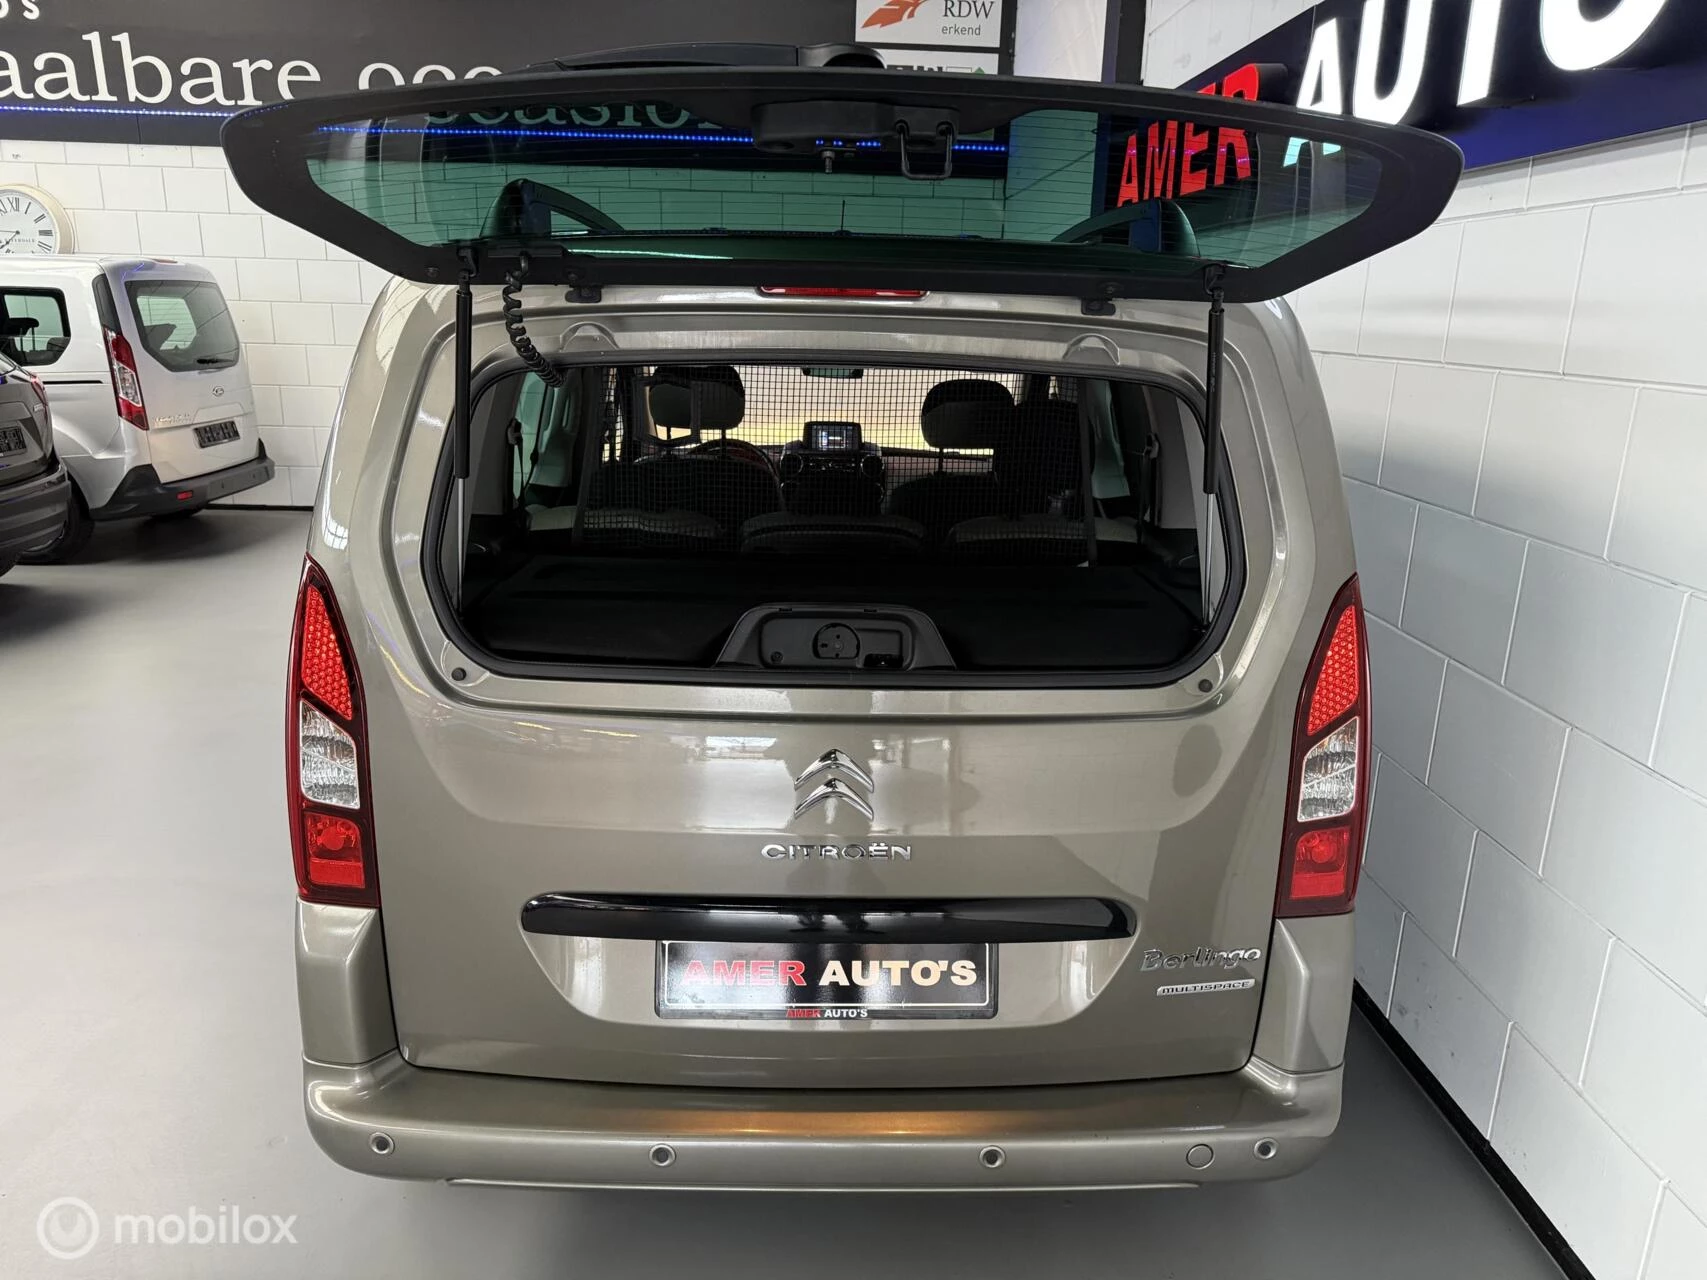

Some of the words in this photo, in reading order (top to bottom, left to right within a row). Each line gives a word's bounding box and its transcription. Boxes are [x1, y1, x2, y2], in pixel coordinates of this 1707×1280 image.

[943, 0, 994, 19] RDW
[941, 25, 981, 36] erkend
[1117, 63, 1259, 207] AMER
[761, 842, 911, 860] CITROËN
[1140, 946, 1261, 971] Berlingo
[680, 959, 807, 986] AMER
[818, 959, 977, 987] AUTO'S
[1162, 981, 1249, 994] MULTISPACE
[786, 1008, 820, 1018] AMER
[823, 1008, 868, 1018] AUTO'S
